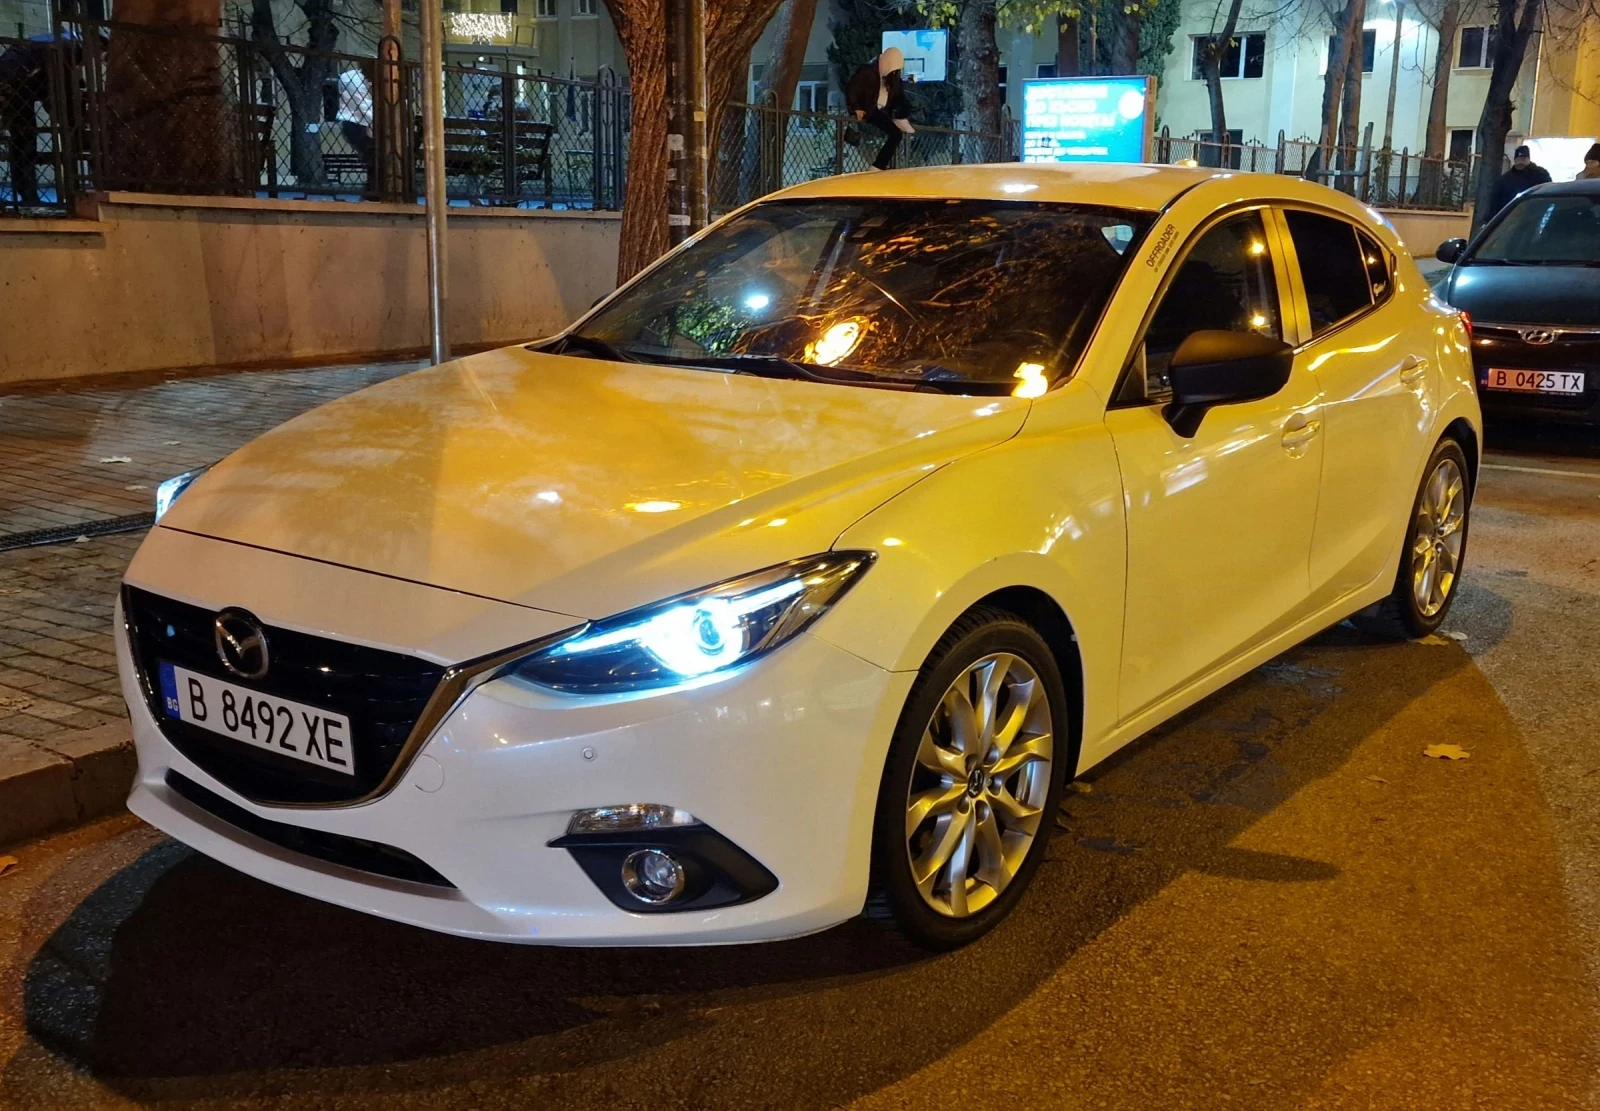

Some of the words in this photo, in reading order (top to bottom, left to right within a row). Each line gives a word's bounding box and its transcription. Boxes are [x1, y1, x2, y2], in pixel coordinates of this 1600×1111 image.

[1146, 224, 1176, 267] OFFROADER
[1496, 371, 1506, 386] B
[1516, 372, 1555, 388] 0425
[1560, 375, 1581, 390] TX
[166, 697, 179, 712] BG
[188, 677, 207, 722] B
